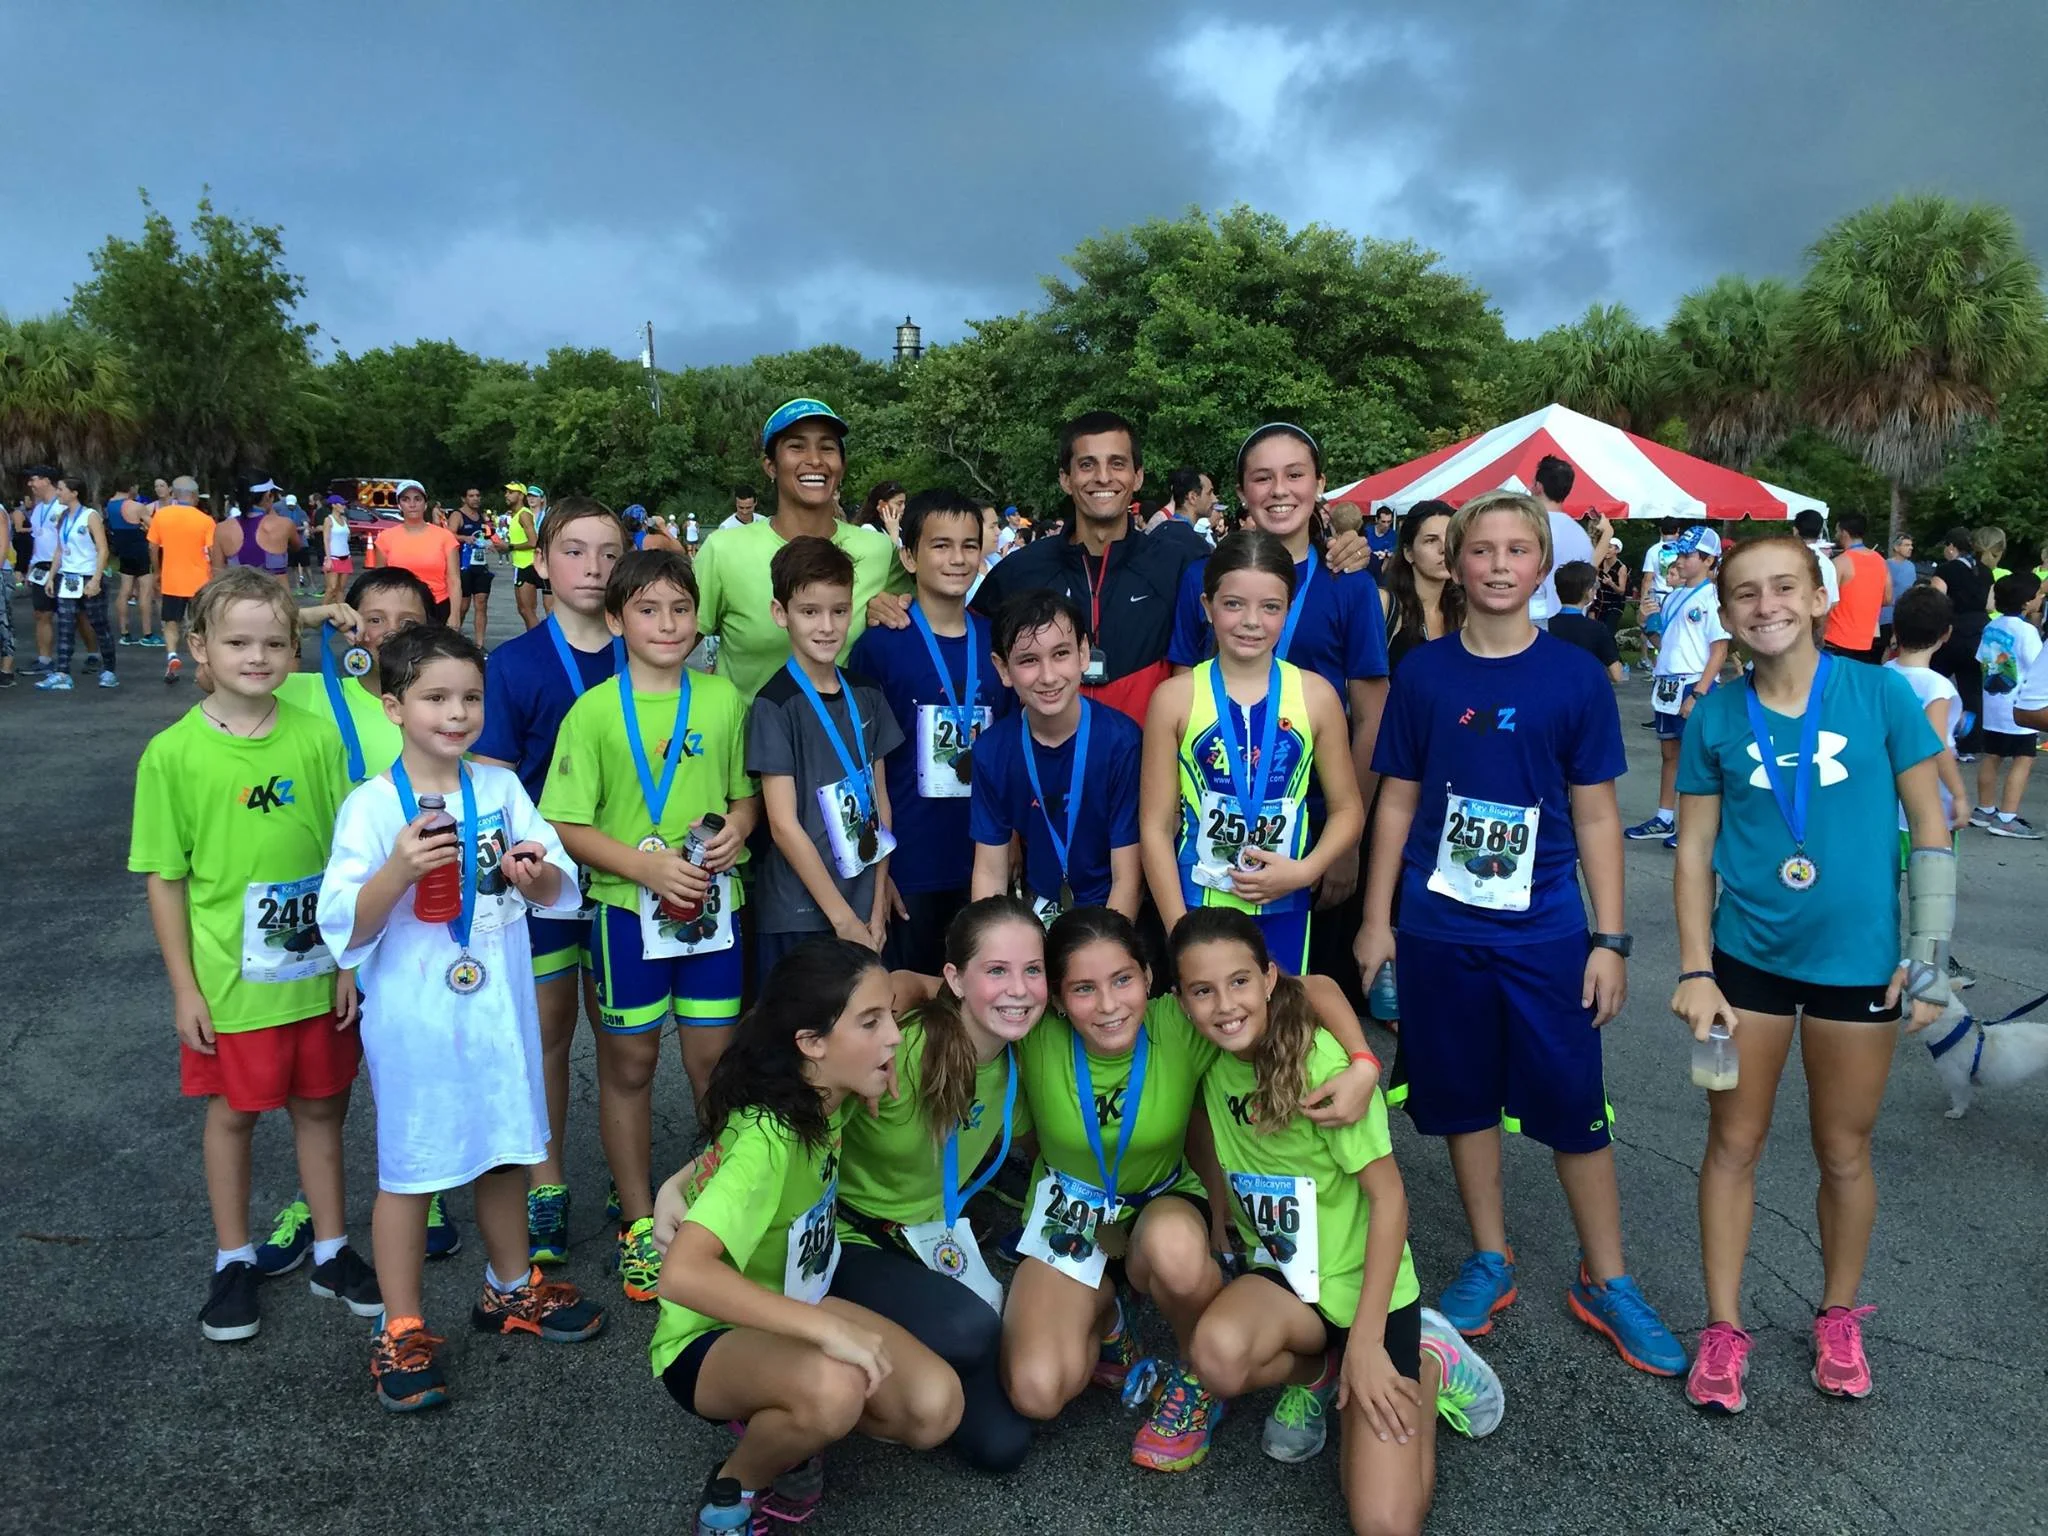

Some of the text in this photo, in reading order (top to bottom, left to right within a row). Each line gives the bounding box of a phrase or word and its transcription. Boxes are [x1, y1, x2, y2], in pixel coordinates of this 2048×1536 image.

[1207, 808, 1287, 846] 2582
[1447, 812, 1530, 855] 2589
[1238, 1176, 1293, 1190] Key Biscayne
